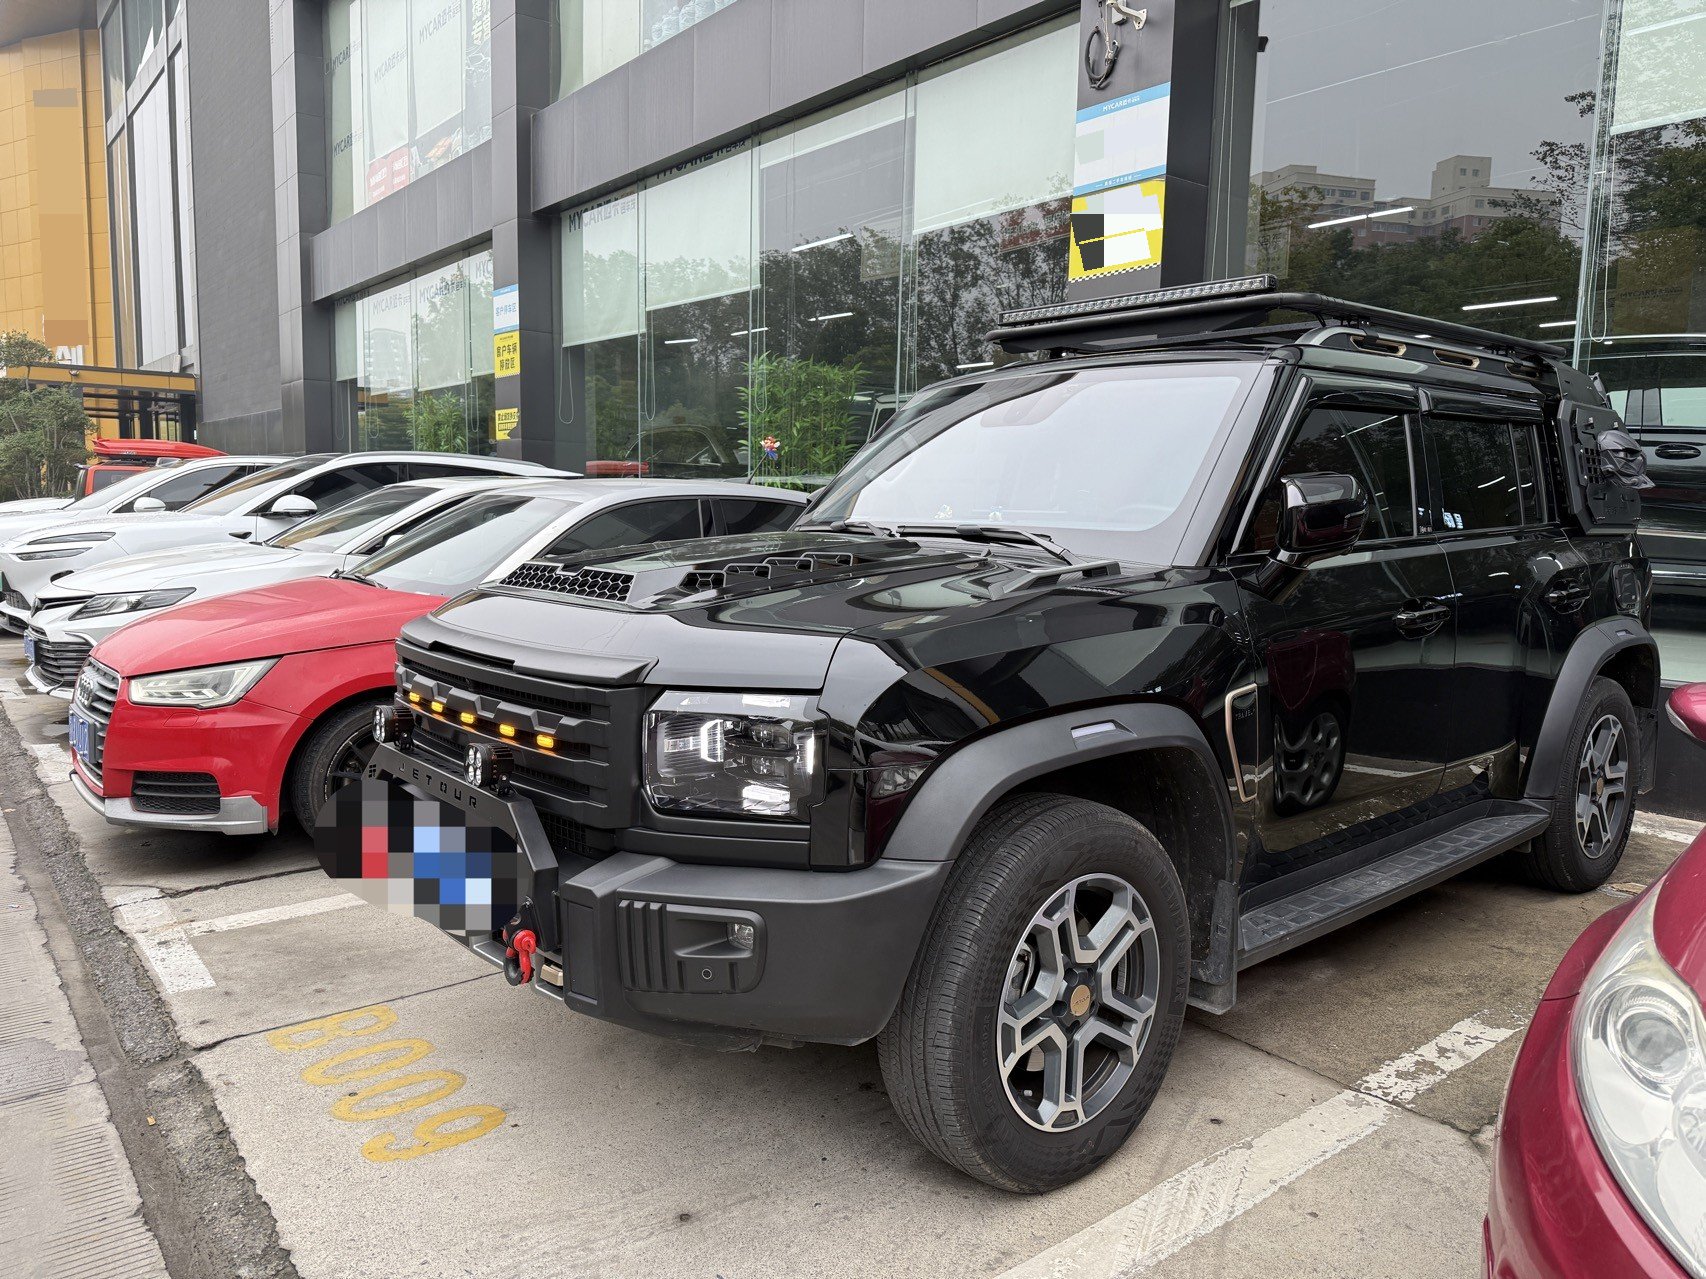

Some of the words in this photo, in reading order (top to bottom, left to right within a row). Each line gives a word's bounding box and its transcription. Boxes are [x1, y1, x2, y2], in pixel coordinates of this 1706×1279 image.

[496, 342, 518, 358] 客户车辆
[398, 762, 477, 808] JETOUR
[265, 1004, 508, 1162] B009
